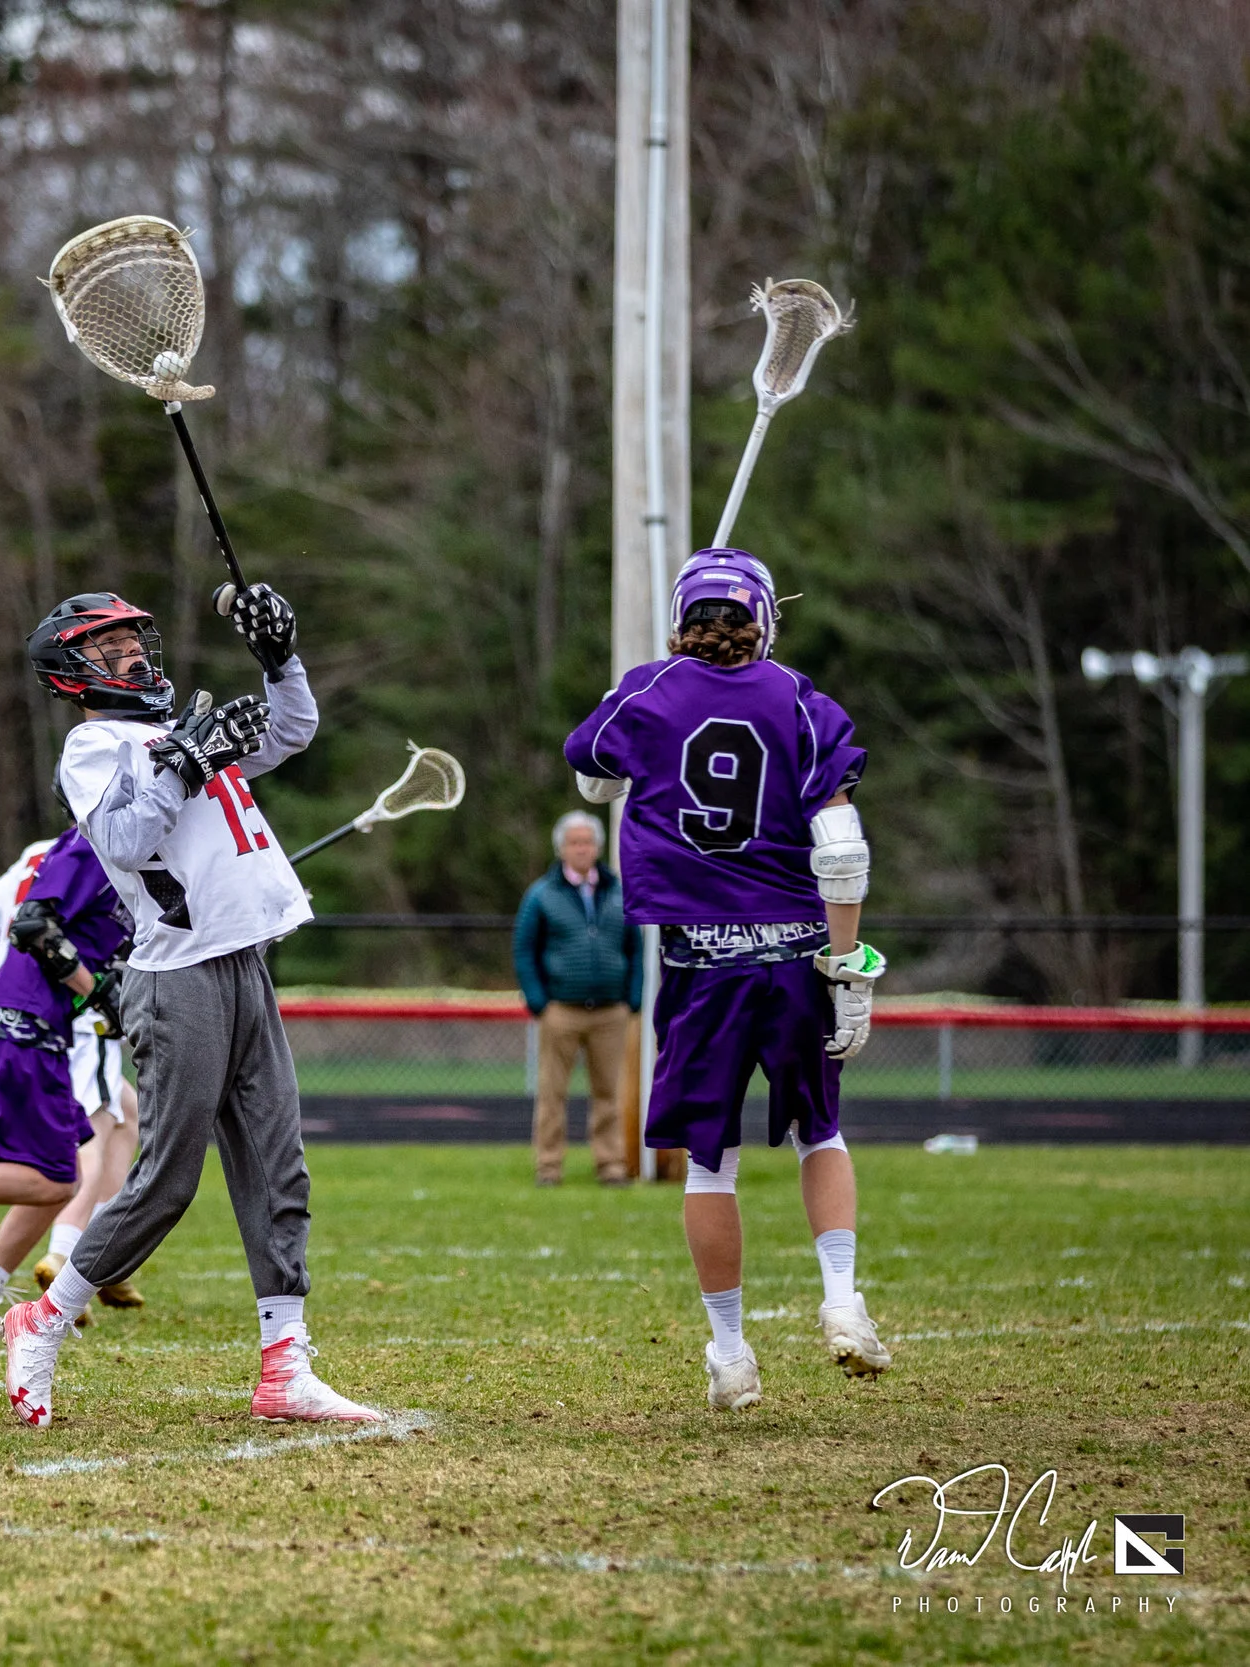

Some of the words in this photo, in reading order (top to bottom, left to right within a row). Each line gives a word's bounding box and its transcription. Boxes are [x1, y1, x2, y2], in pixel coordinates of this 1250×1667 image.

[180, 736, 215, 782] BRINE
[678, 717, 769, 855] 9
[817, 852, 869, 867] MAVERI
